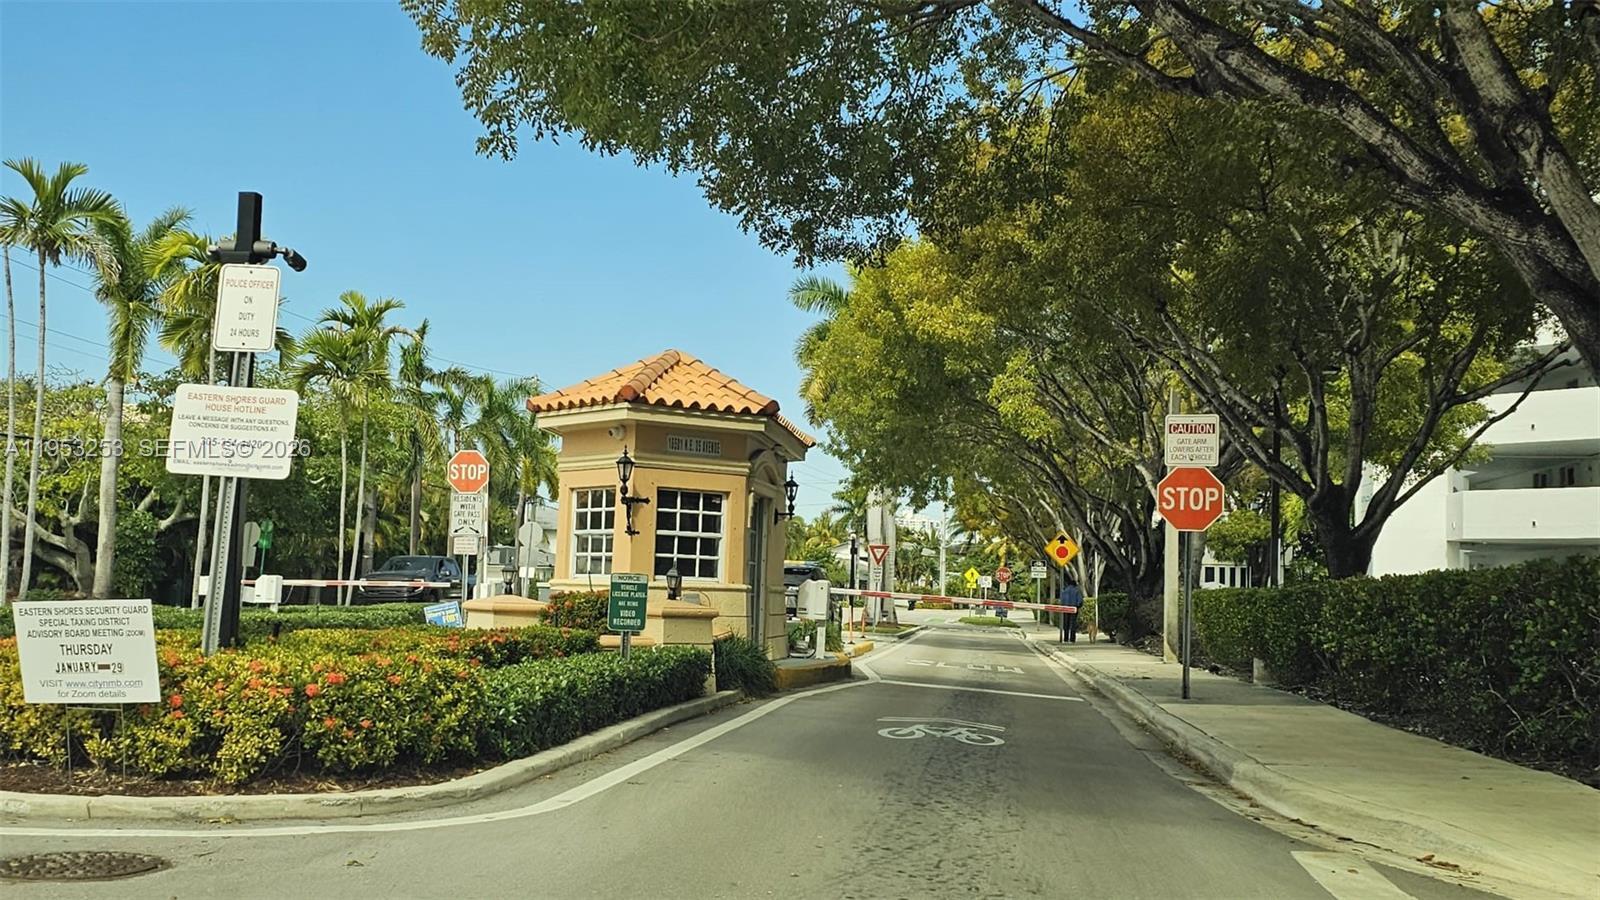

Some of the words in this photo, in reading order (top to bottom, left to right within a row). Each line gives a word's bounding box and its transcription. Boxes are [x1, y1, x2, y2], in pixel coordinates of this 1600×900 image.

[226, 278, 248, 288] POLICE
[249, 280, 274, 289] OFFICER
[244, 296, 253, 304] ON
[238, 312, 254, 320] DUTY
[230, 328, 237, 336] 24
[238, 328, 260, 338] HOURS
[187, 392, 224, 401] EASTERN
[226, 394, 257, 404] SHORES
[259, 397, 286, 405] GUARD
[205, 404, 232, 412] HOUSE
[234, 405, 266, 414] HOTLINE
[1170, 424, 1213, 434] CAUTION
[450, 464, 486, 480] STOP
[1162, 487, 1219, 511] STOP
[19, 607, 52, 616] EASTERN
[54, 606, 84, 616] SHORES
[85, 606, 120, 615] SECURITY
[123, 605, 148, 614] GUARD
[39, 618, 69, 627] SPECIAL
[71, 618, 96, 626] TAXING
[98, 617, 130, 625] DISTRICT
[27, 630, 63, 638] ADVISORY
[65, 630, 90, 638] BOARD
[92, 629, 124, 637] MEETING
[60, 643, 113, 656] THURSDAY
[56, 662, 97, 674] JANUARY
[112, 662, 123, 674] 29
[39, 680, 64, 688] VISIT
[66, 679, 143, 688] www.citynmb.com
[58, 690, 69, 698] for
[71, 690, 96, 698] Zoom
[98, 690, 126, 698] details
